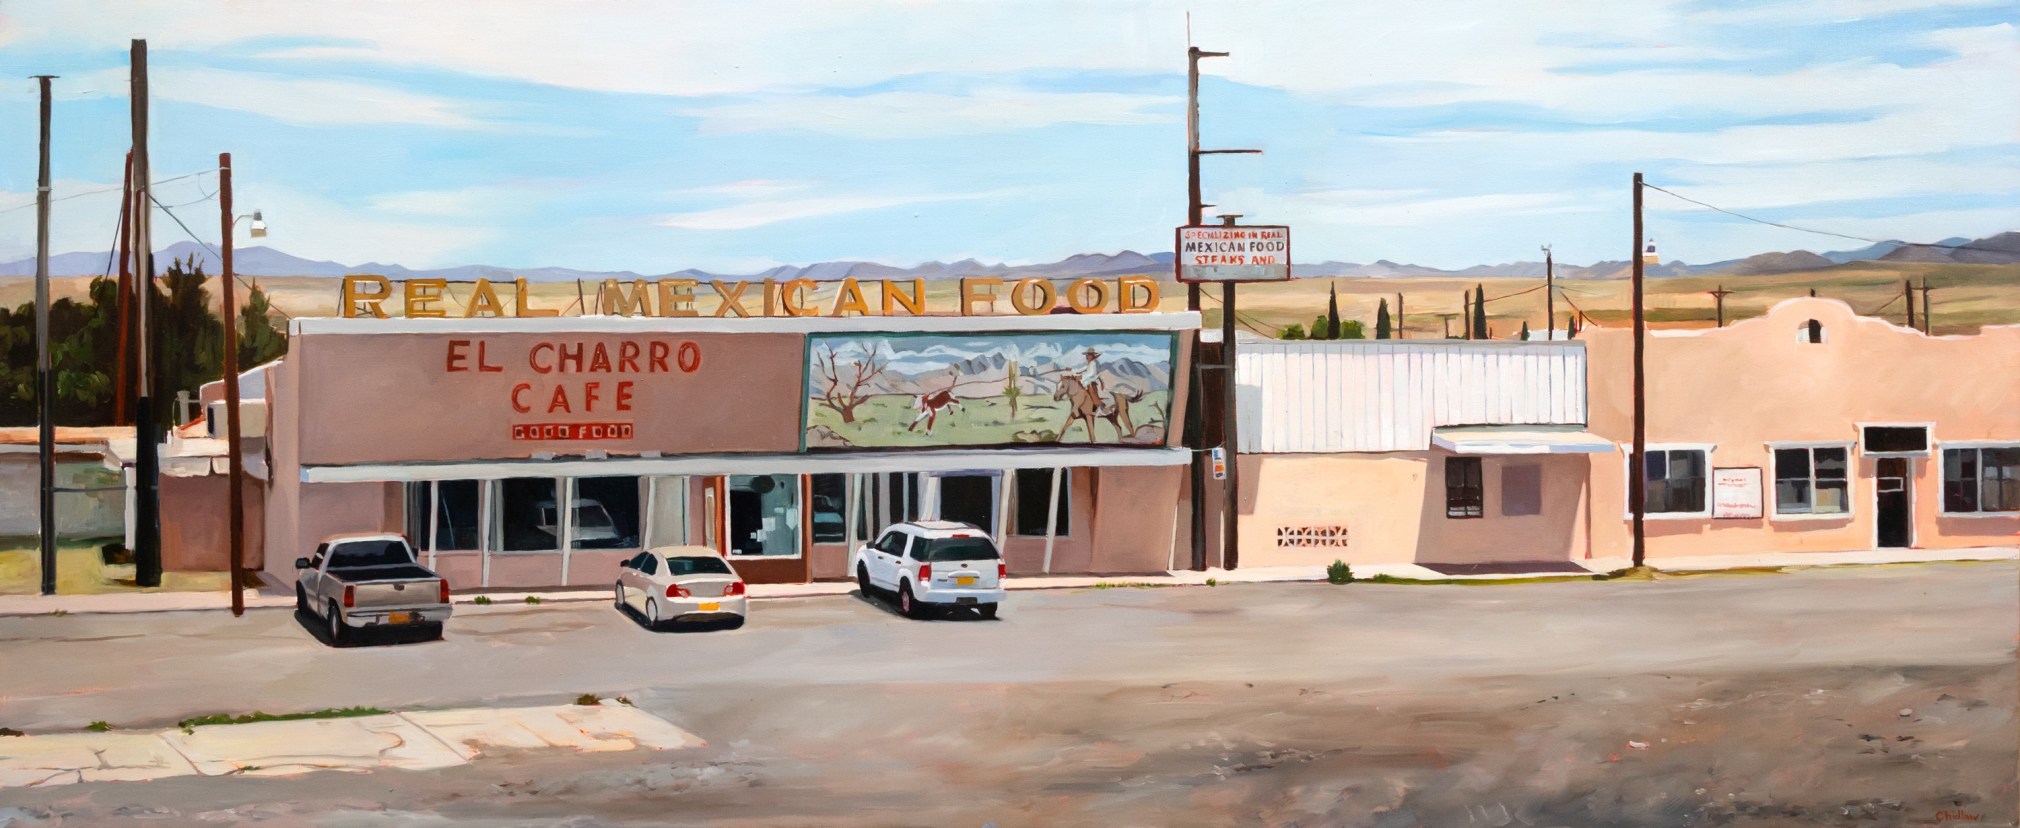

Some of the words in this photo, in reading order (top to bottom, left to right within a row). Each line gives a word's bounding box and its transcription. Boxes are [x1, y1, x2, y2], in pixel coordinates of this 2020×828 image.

[1248, 231, 1258, 239] IN
[1261, 231, 1283, 240] REAL
[1185, 242, 1246, 252] MEXICAN
[1249, 242, 1285, 252] FOOD
[1195, 255, 1245, 265] STEAKS
[1251, 255, 1276, 265] AND
[342, 274, 560, 319] REAL
[602, 277, 926, 318] MEXICAN
[960, 275, 1161, 315] FOOD
[446, 340, 503, 373] EL
[529, 341, 701, 374] CHARRO
[511, 381, 635, 414] CAFE
[579, 424, 632, 438] FOOD
